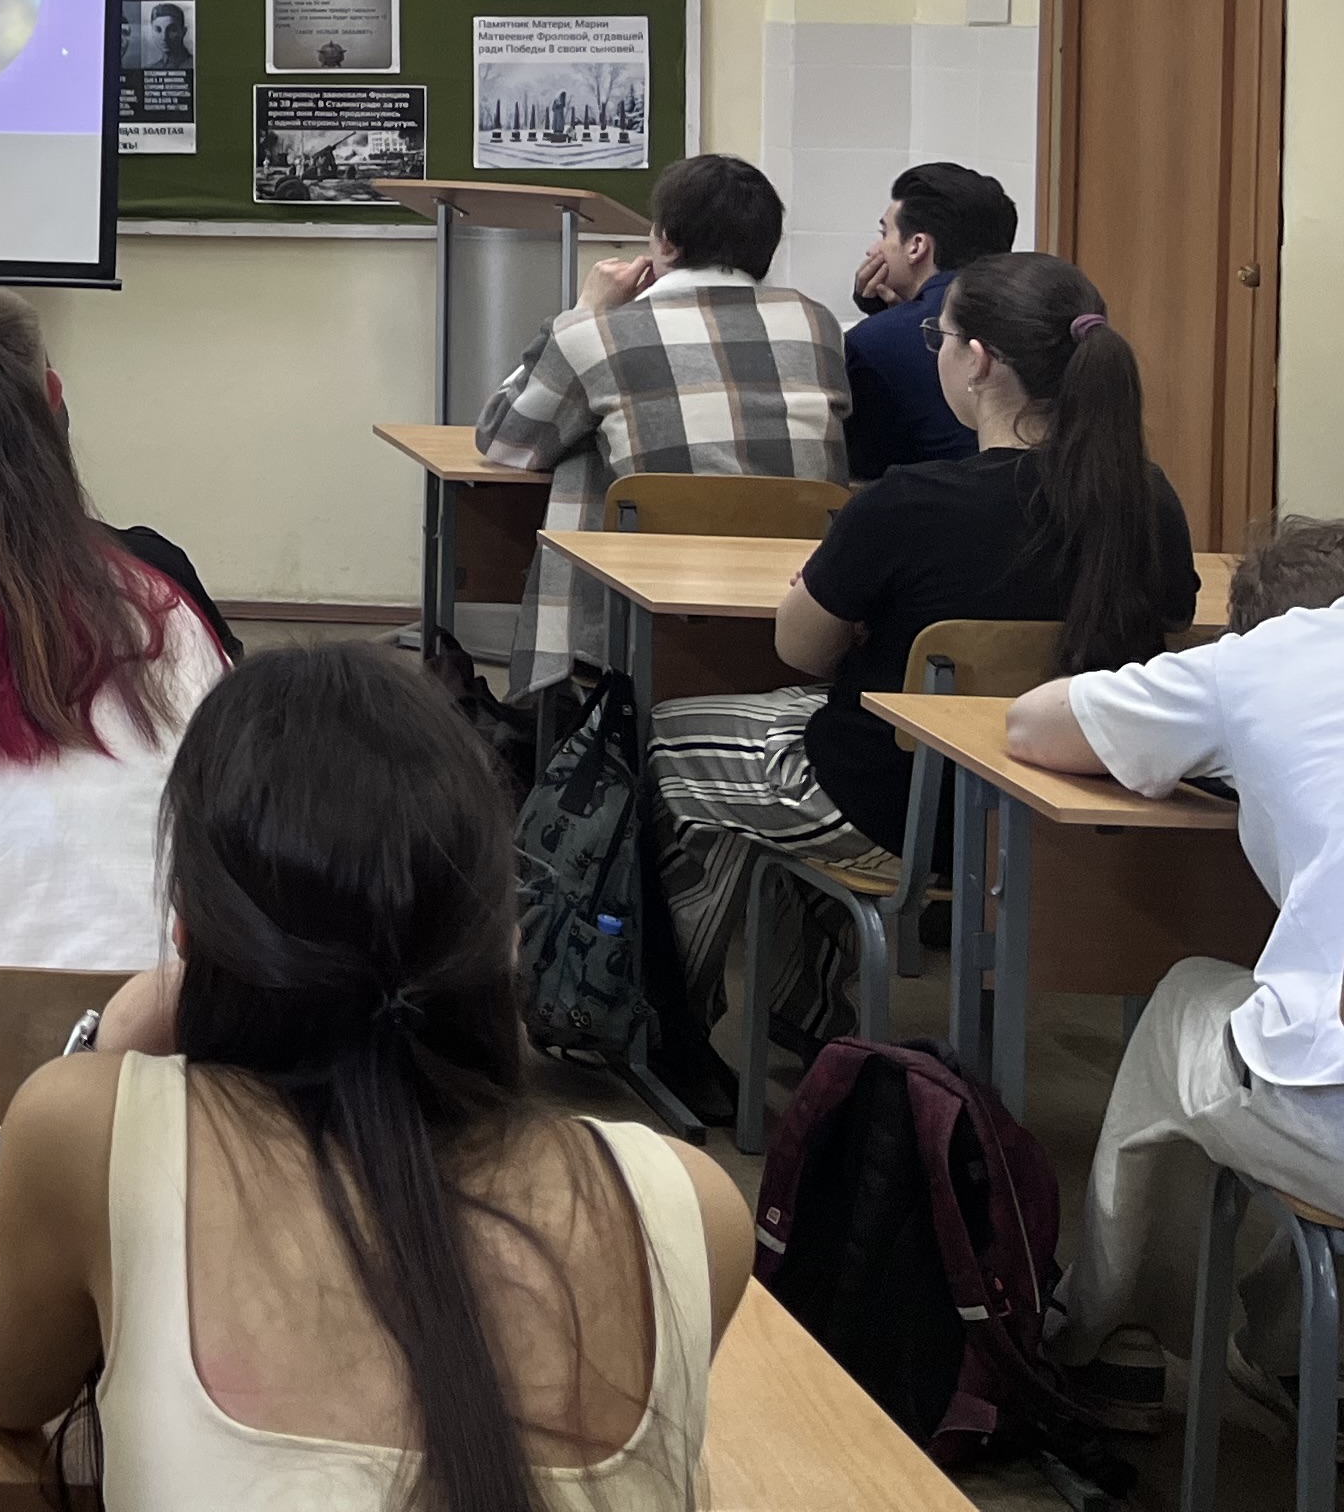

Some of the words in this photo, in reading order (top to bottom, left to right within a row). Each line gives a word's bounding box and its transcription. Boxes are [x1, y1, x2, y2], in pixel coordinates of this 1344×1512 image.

[478, 20, 529, 29] Памятник
[532, 20, 572, 30] Матери,
[575, 20, 609, 29] Марии
[478, 33, 534, 41] Матвеевне
[536, 32, 590, 43] Фроловой,
[593, 32, 644, 42] отдавшей
[478, 46, 503, 54] ради
[506, 45, 546, 54] Победы
[557, 46, 587, 54] своих
[143, 127, 184, 136] ЗОЛОТАЯ
